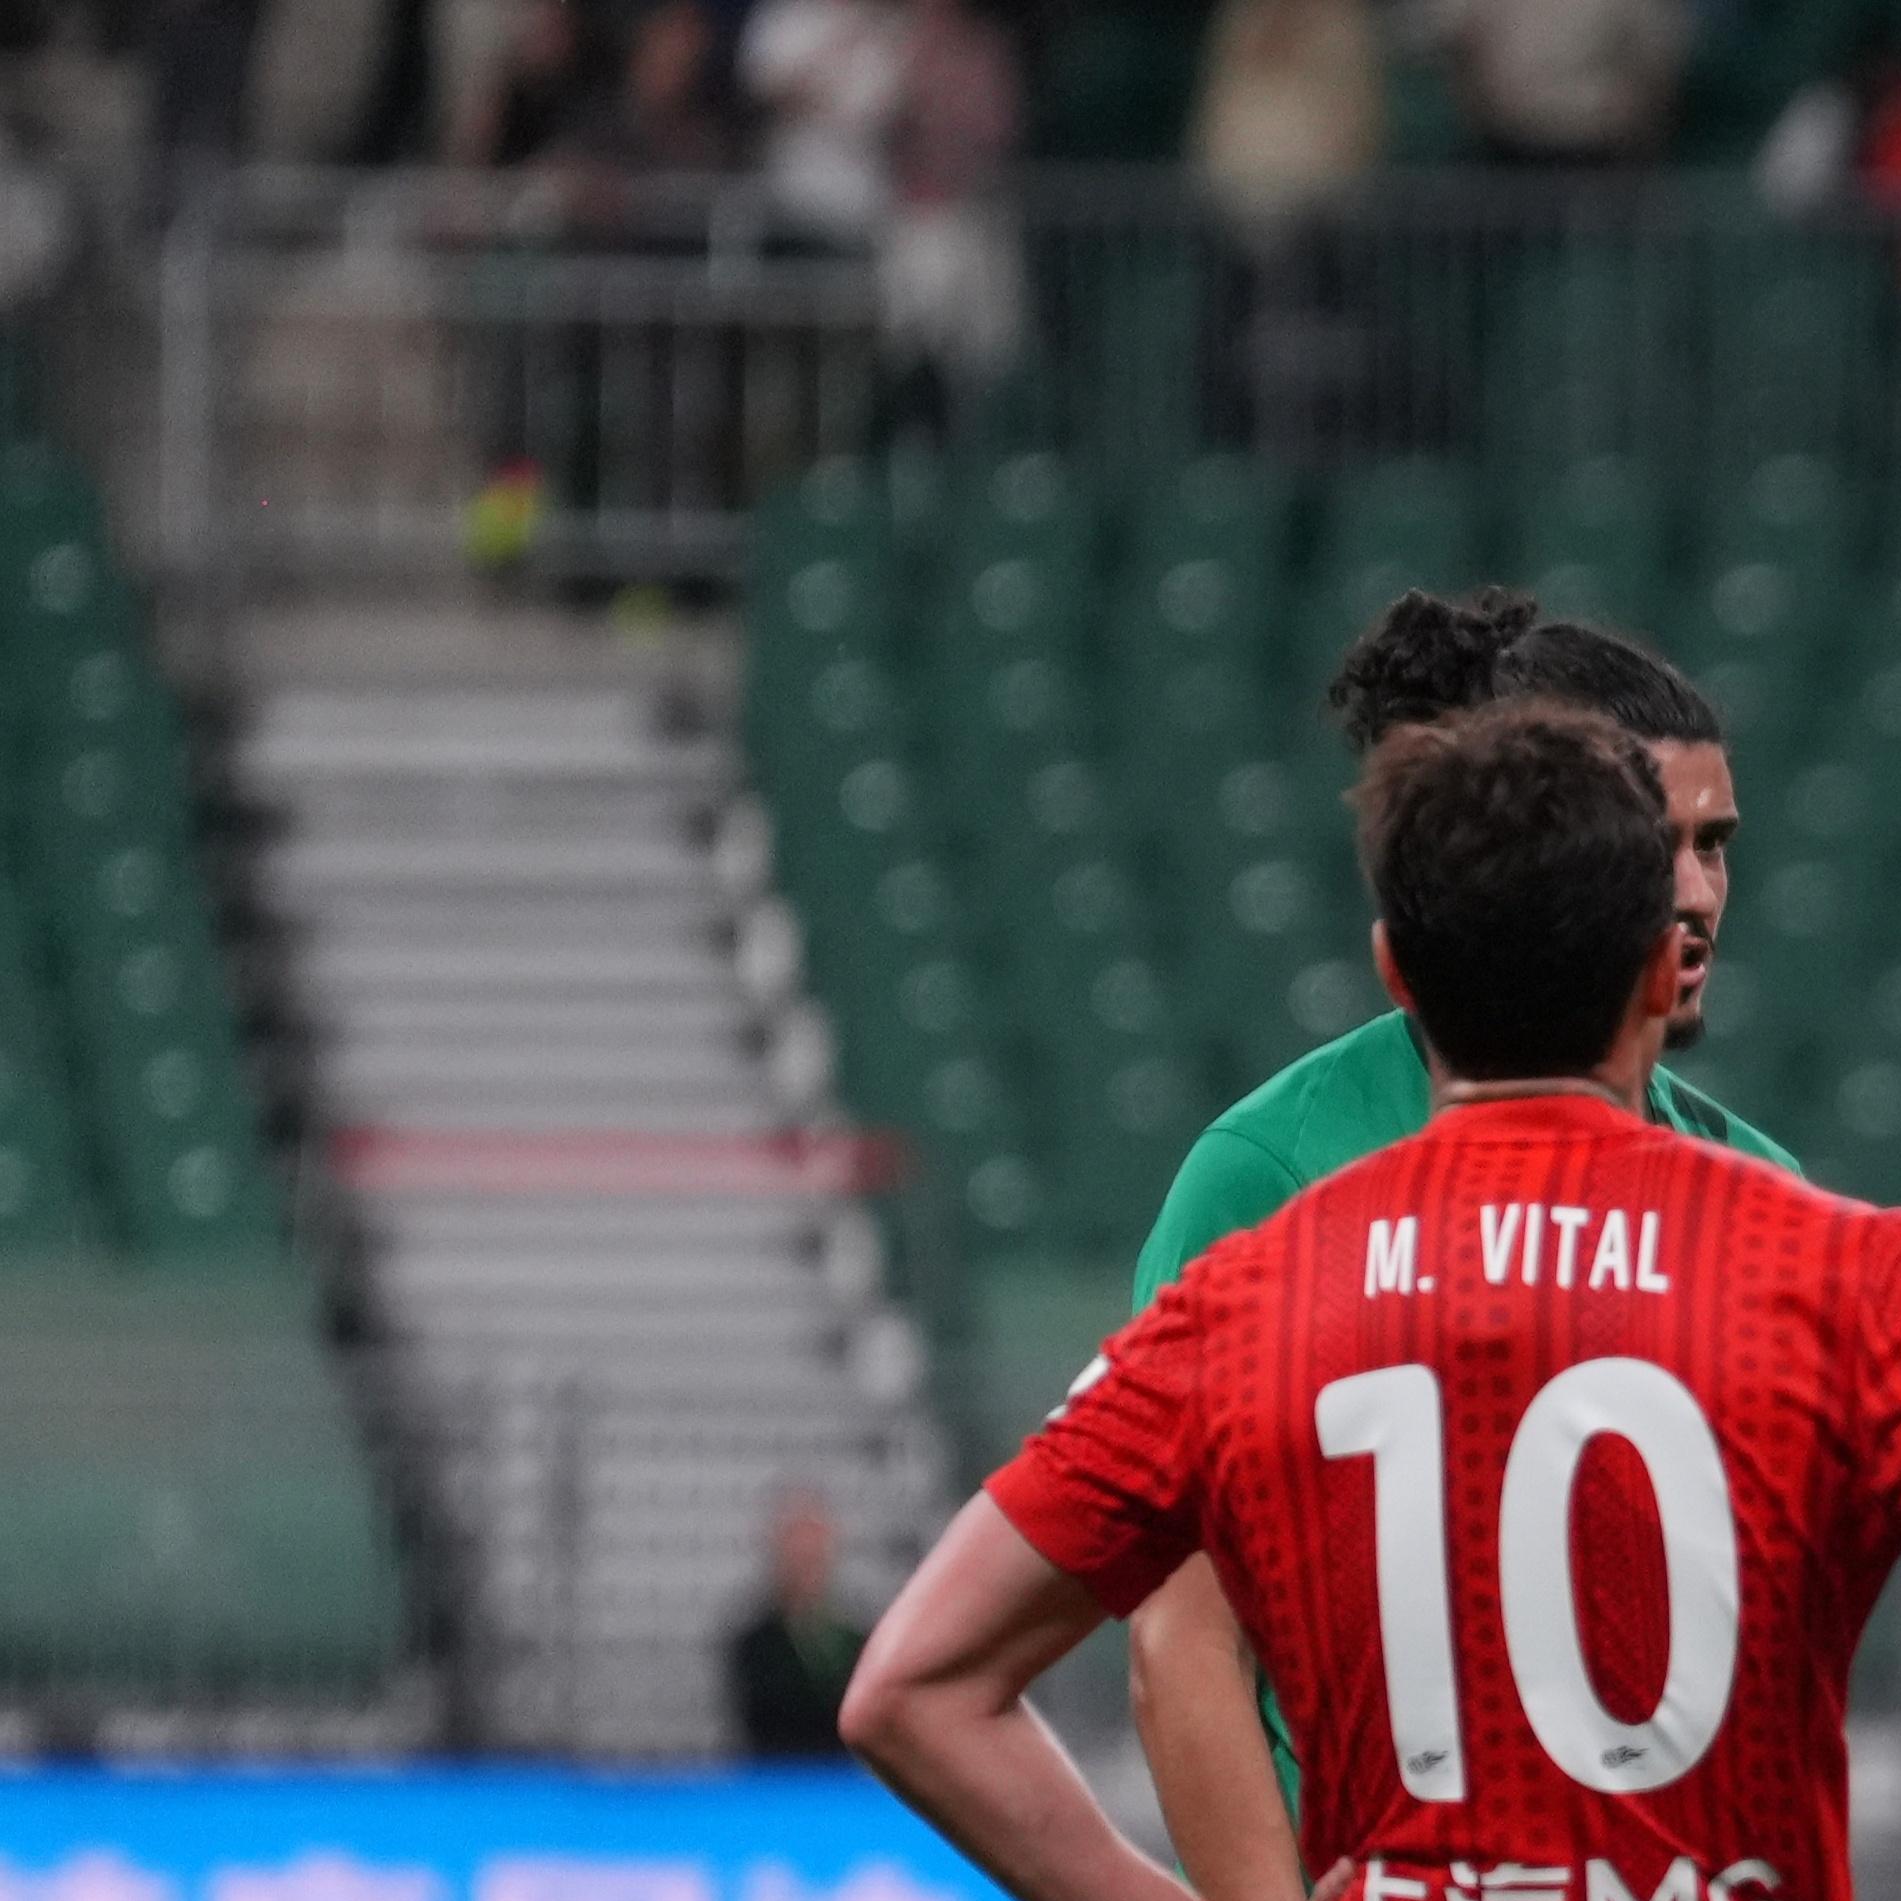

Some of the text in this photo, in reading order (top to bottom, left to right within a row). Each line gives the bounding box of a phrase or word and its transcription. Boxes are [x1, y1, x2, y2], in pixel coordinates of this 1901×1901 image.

[1364, 1202, 1670, 1299] M. VITAL
[1315, 1356, 1740, 1801] 10
